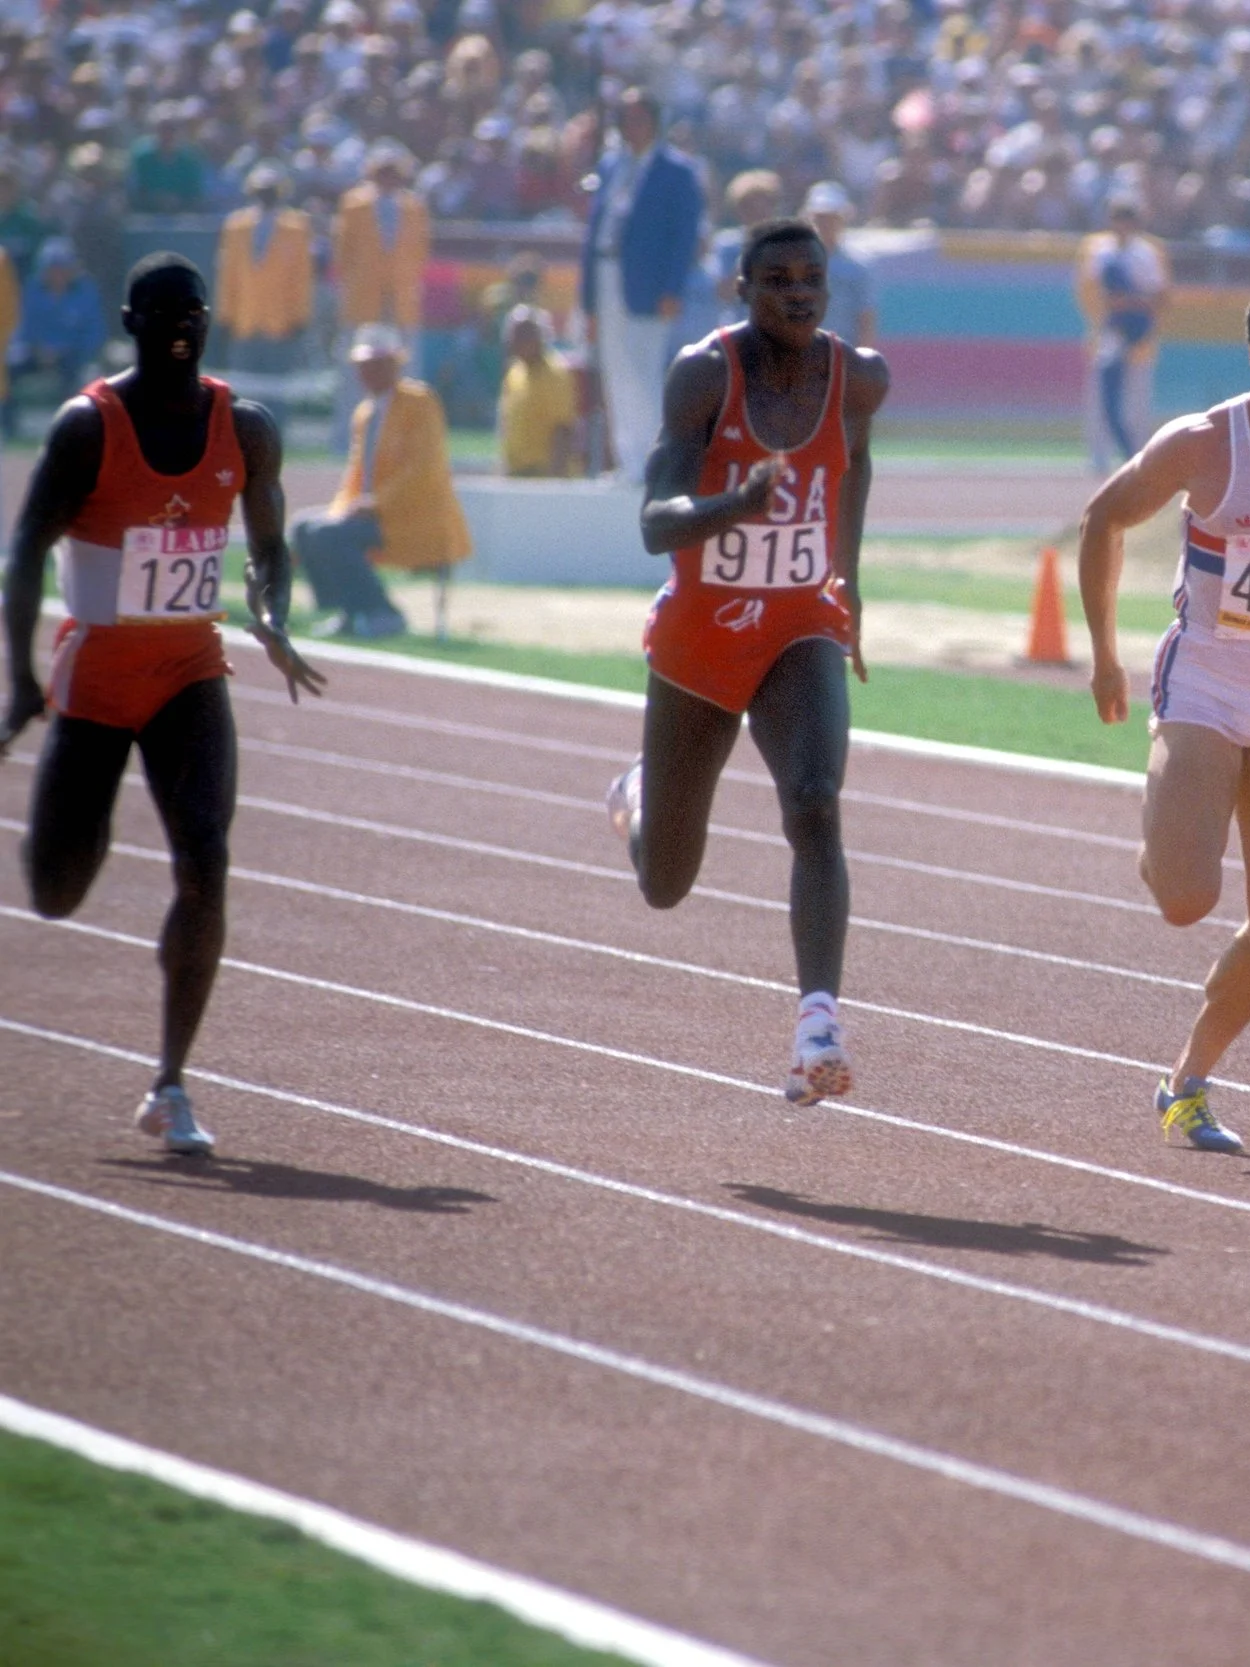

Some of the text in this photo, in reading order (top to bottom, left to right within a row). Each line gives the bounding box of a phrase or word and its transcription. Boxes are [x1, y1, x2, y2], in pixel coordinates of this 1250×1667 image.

[726, 461, 827, 523] SA
[140, 555, 219, 612] 126
[714, 528, 815, 584] 915
